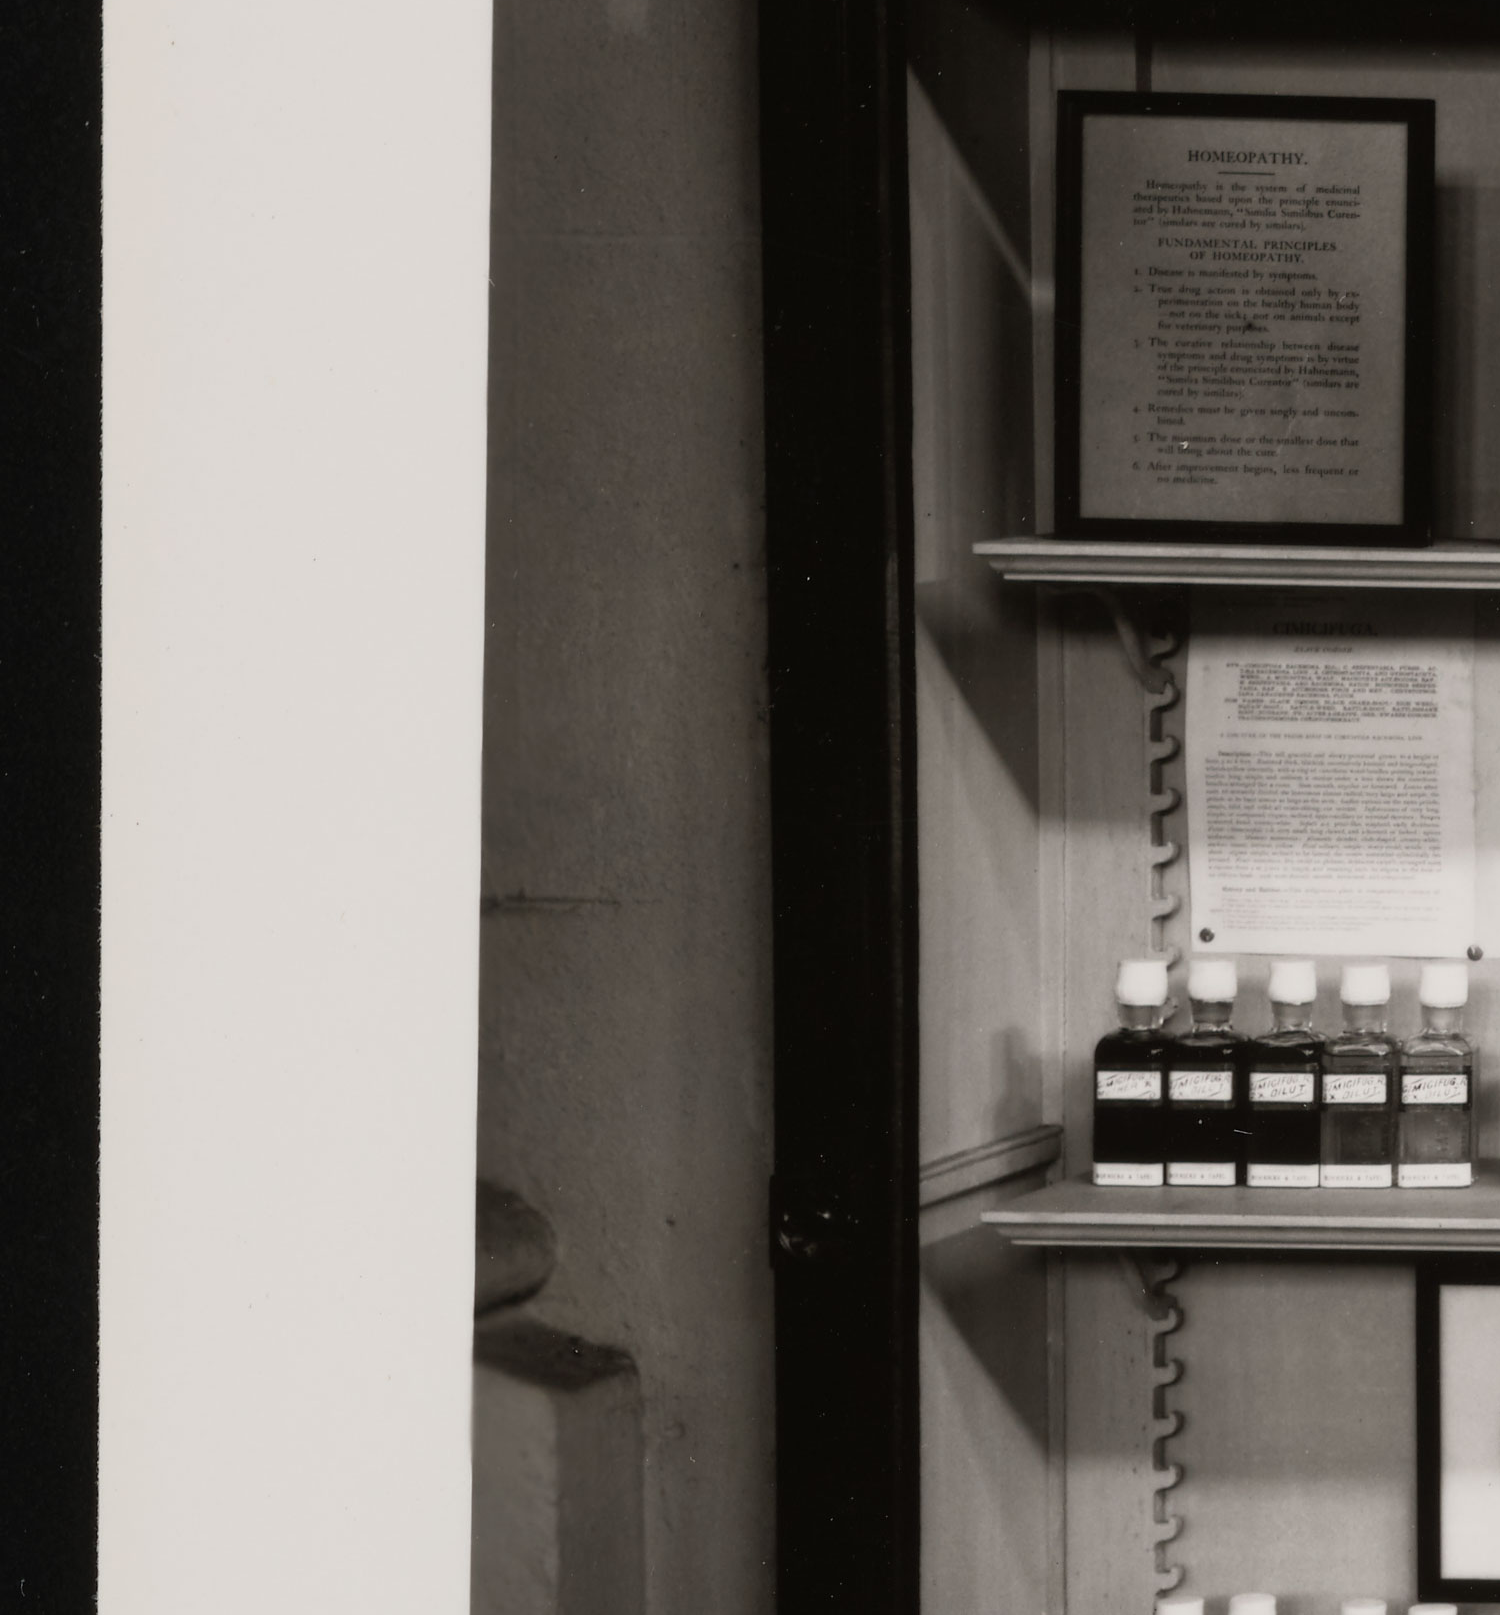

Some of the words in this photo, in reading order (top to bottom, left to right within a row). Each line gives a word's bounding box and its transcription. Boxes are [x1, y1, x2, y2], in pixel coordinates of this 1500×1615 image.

[1188, 150, 1308, 165] HOMEOPATHY.
[1231, 181, 1245, 191] the
[1158, 237, 1257, 250] FUNDAMENTAL
[1264, 241, 1336, 251] PRINCIPLES
[1190, 250, 1205, 260] OF
[1213, 251, 1304, 263] HOMEOPATHY.
